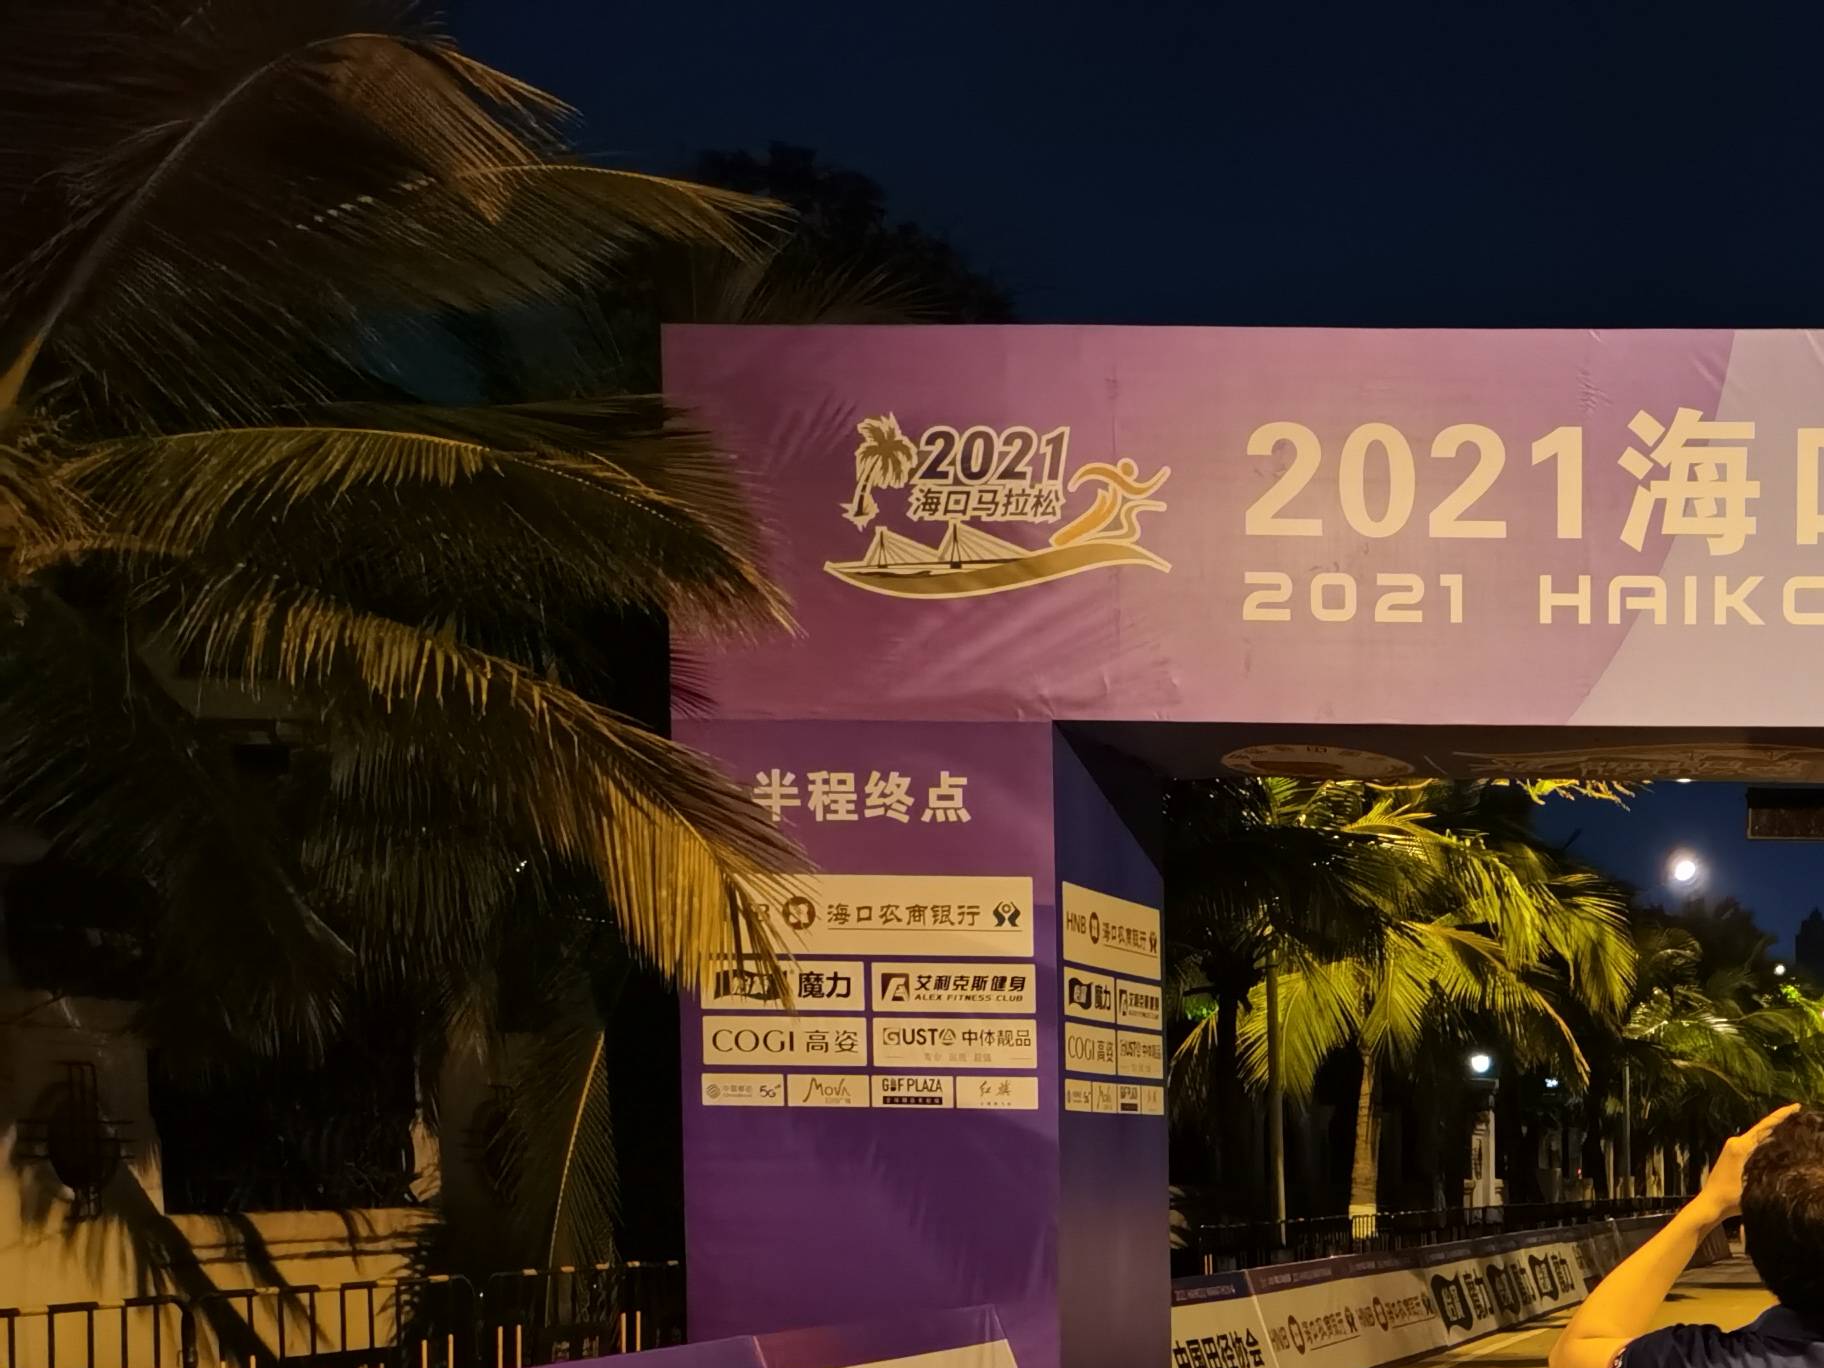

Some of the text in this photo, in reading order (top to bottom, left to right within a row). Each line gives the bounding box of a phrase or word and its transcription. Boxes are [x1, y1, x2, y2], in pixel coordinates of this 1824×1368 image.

[917, 425, 1070, 484] 2021
[907, 483, 1063, 522] 海口马拉松
[1242, 570, 1466, 624] 2021
[752, 768, 973, 823] 半程终点
[826, 903, 981, 927] 海口农商银行
[1066, 911, 1086, 934] HNB
[798, 971, 852, 999] 魔力
[914, 975, 1027, 992] 艾利克斯健身
[946, 994, 992, 1002] FITNESS
[712, 1029, 859, 1054] COGI 高姿
[1067, 1034, 1095, 1060] COGI
[907, 1078, 942, 1093] PLAZA
